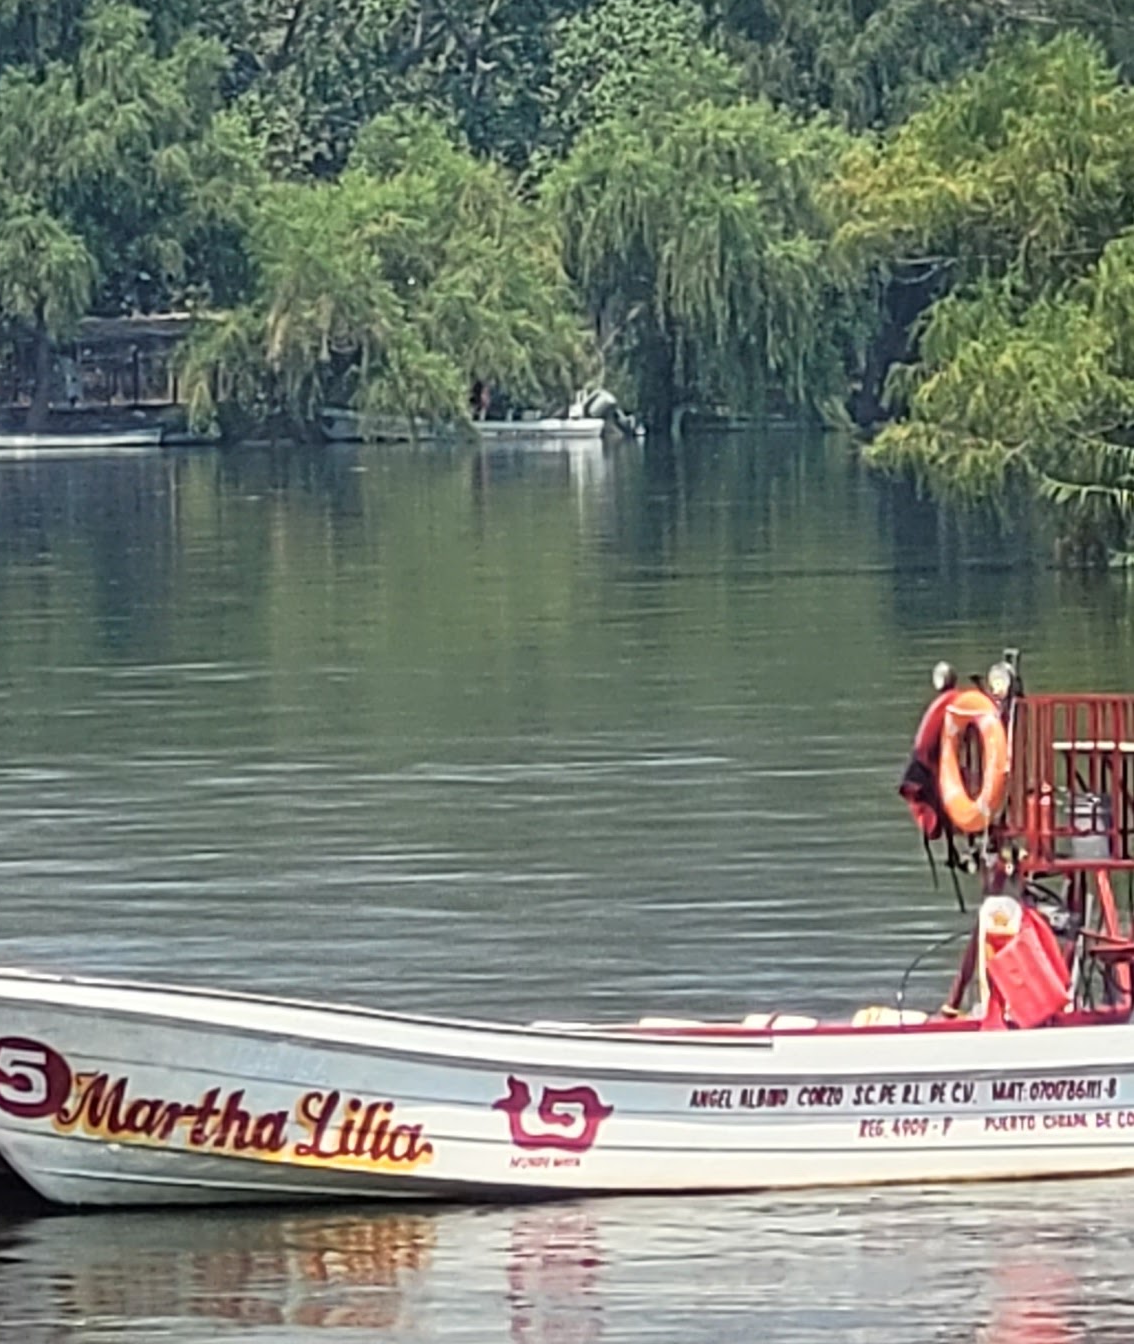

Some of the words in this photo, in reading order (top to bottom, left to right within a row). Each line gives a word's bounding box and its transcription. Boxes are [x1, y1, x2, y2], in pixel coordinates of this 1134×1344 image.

[60, 1071, 289, 1152] Martha
[295, 1090, 434, 1162] Lilia
[690, 1089, 732, 1108] ANGEL
[797, 1086, 844, 1106] CORZO
